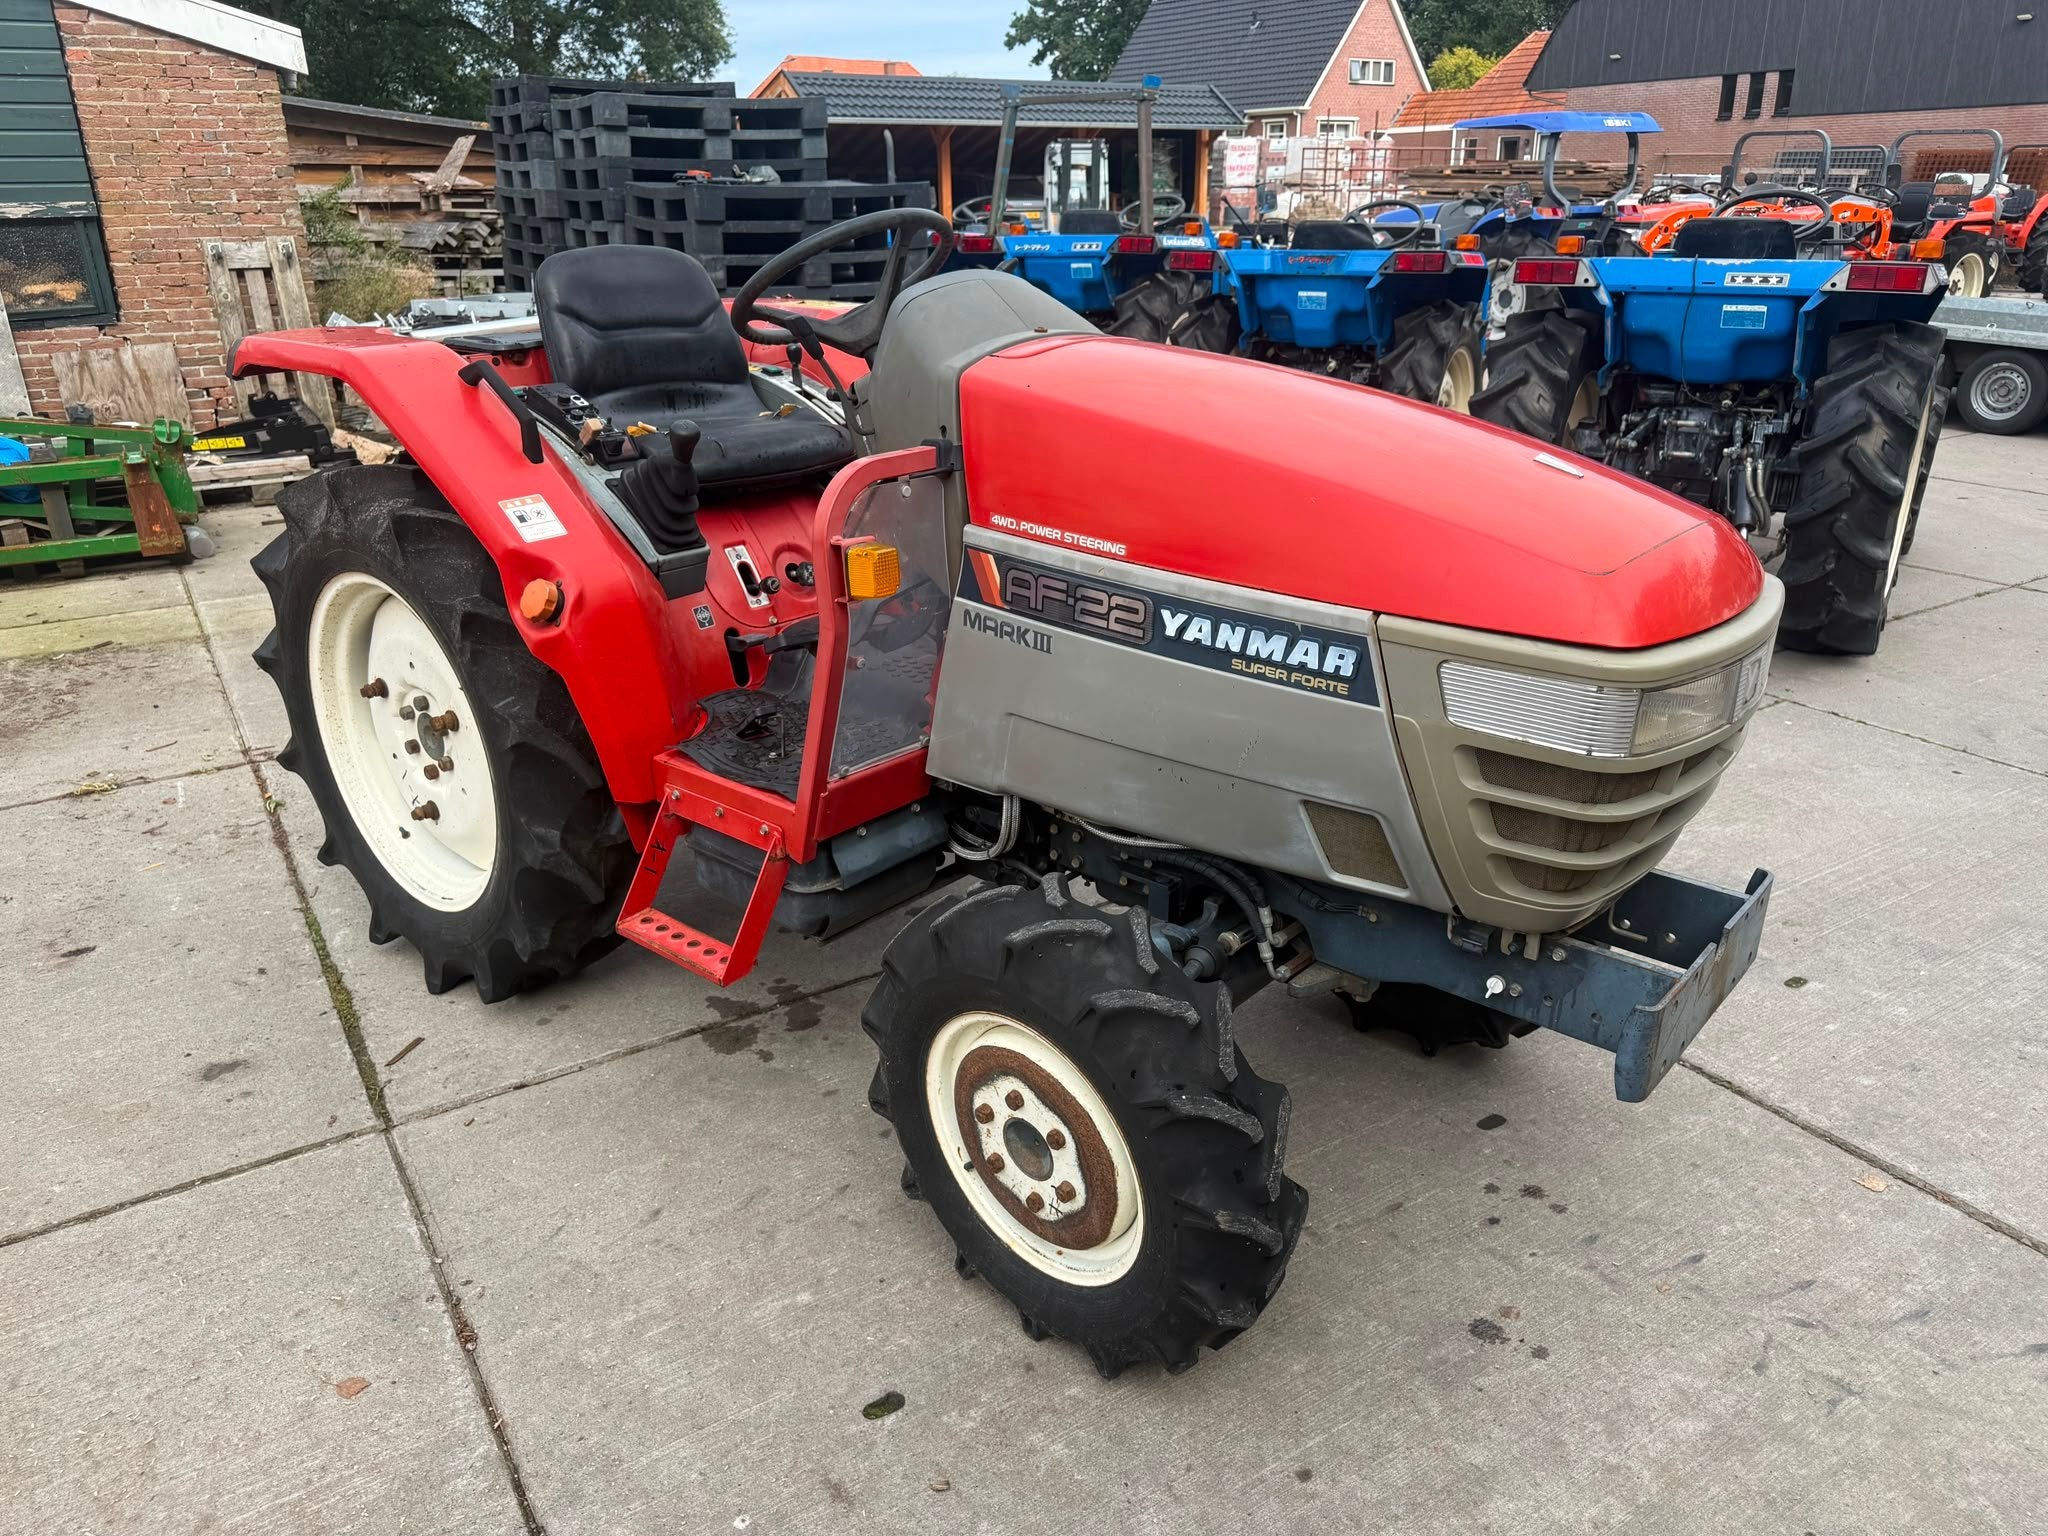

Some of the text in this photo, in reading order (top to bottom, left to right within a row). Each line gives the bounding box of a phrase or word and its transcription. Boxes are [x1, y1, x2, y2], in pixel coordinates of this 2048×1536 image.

[1020, 521, 1062, 541] POWER
[1063, 532, 1126, 556] STEERING
[1160, 608, 1359, 678] YANMAR
[1231, 658, 1350, 696] SUPER FORTE
